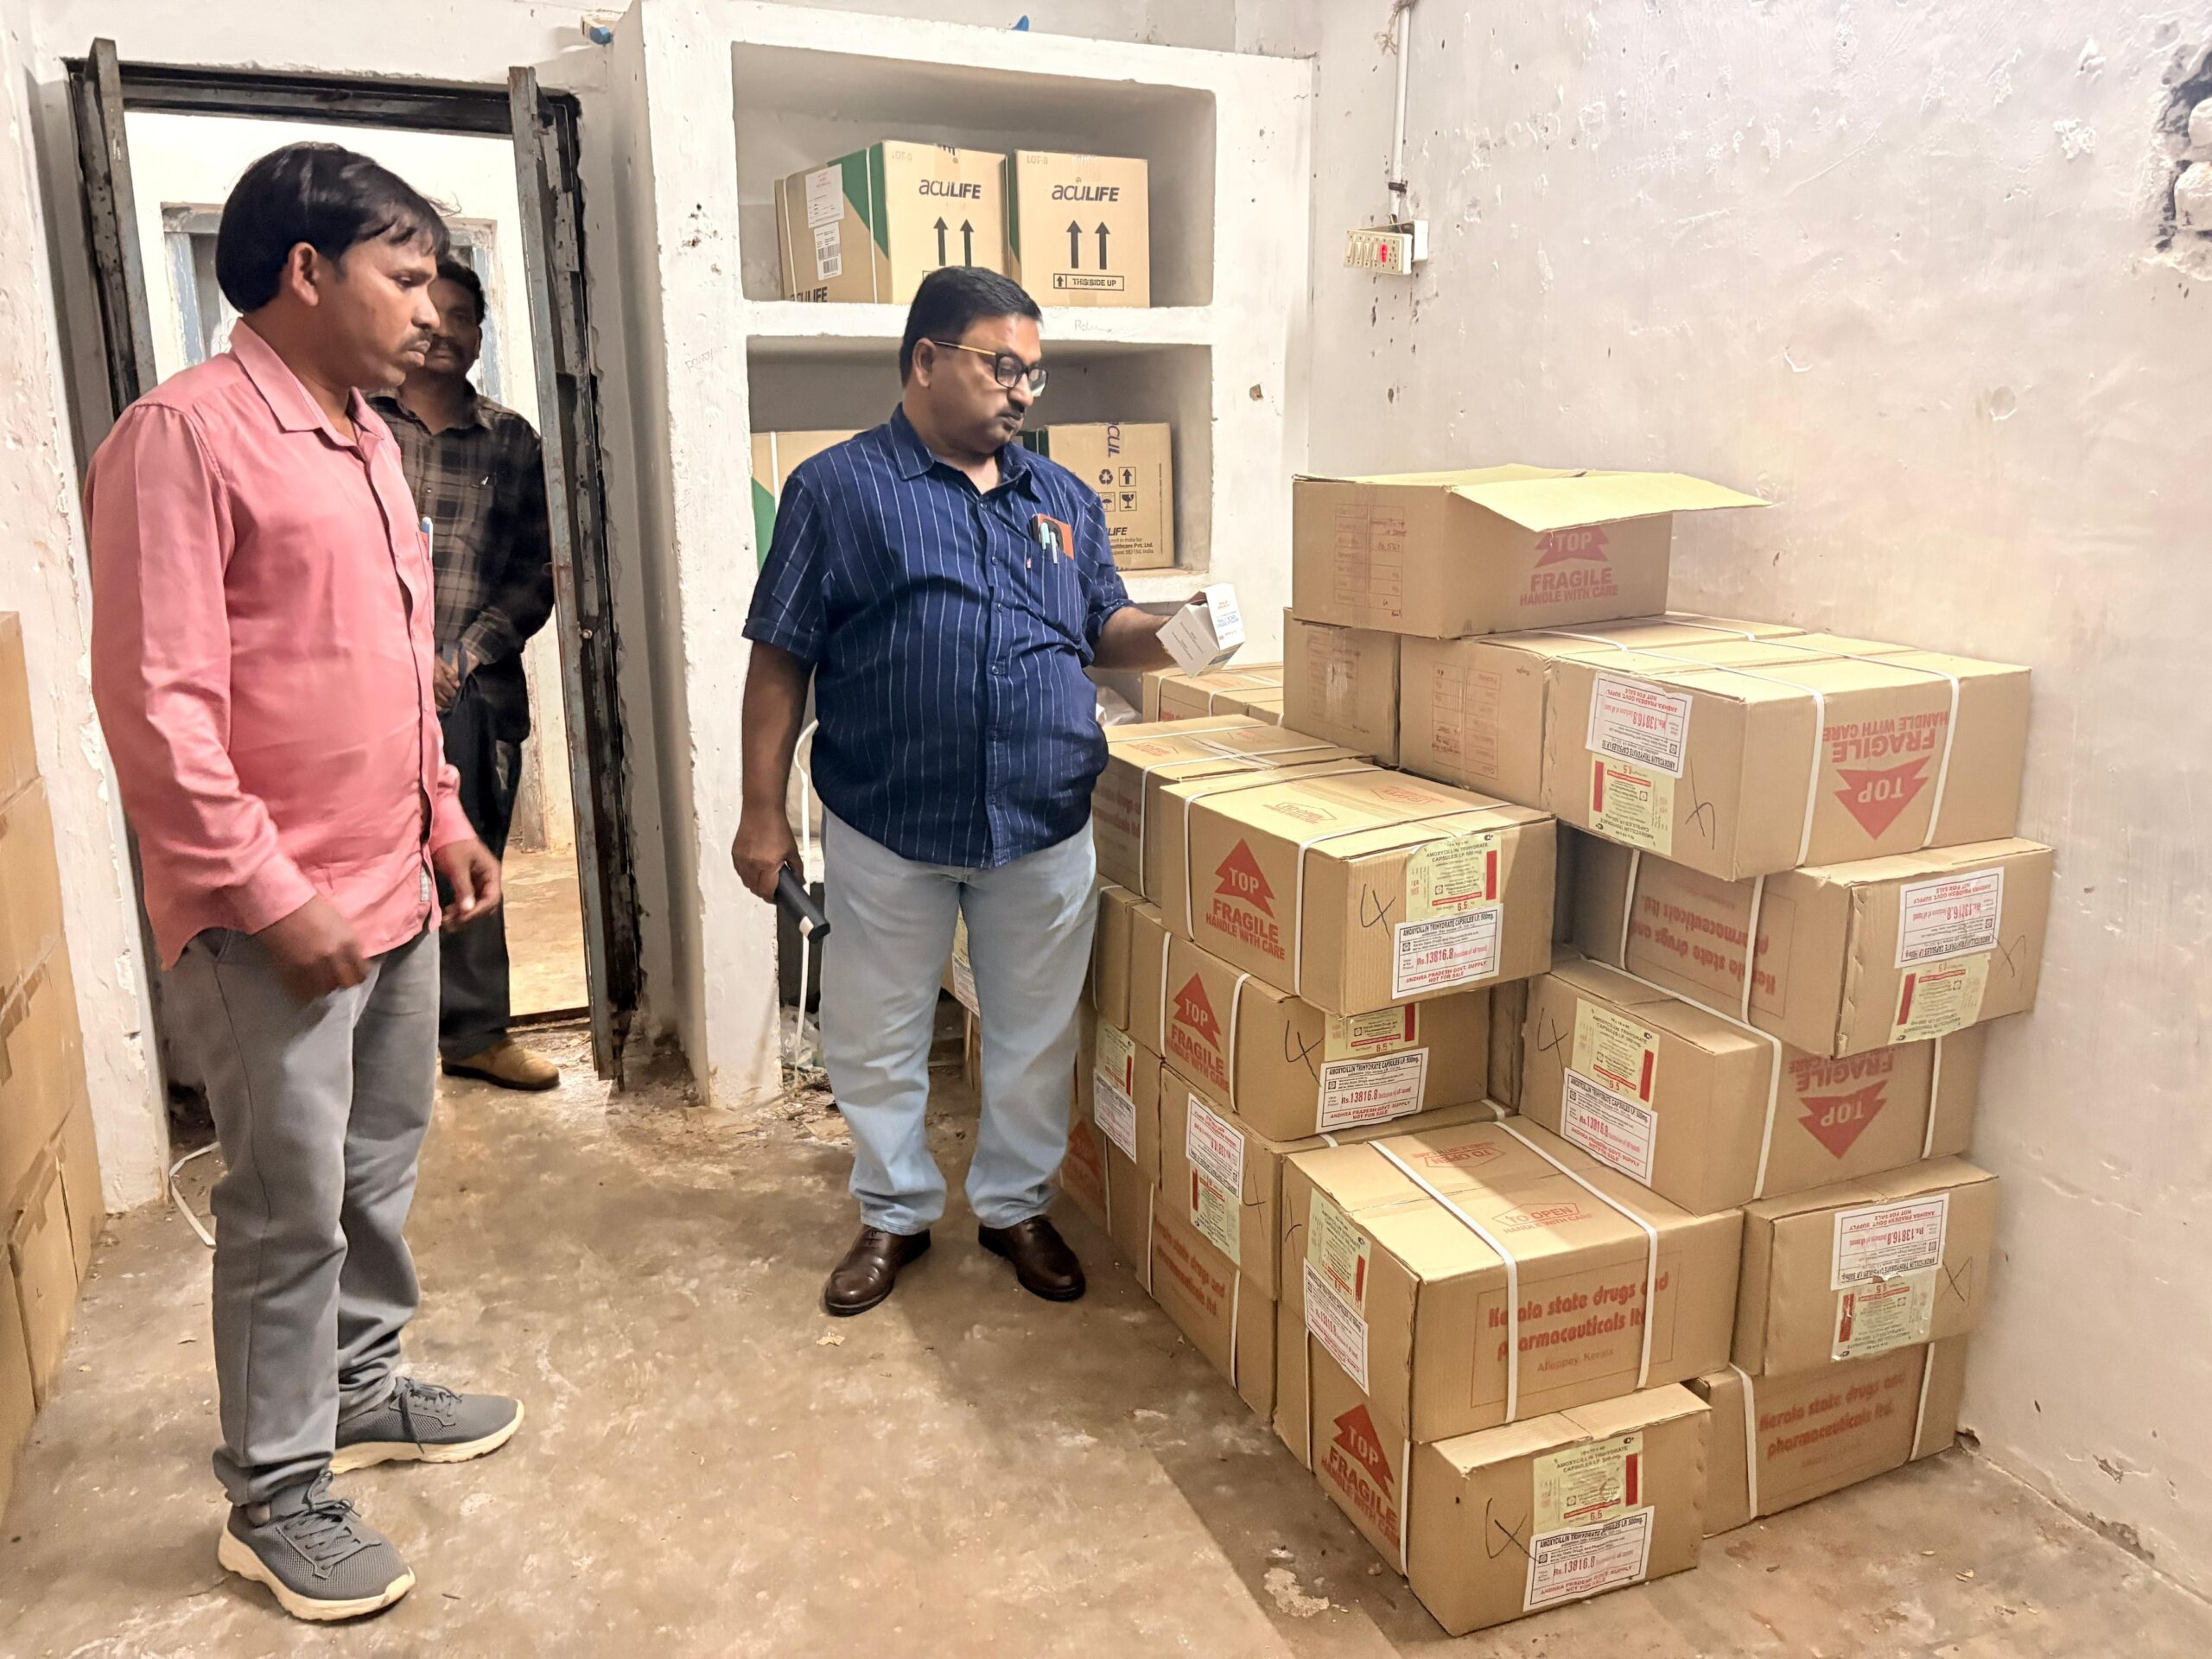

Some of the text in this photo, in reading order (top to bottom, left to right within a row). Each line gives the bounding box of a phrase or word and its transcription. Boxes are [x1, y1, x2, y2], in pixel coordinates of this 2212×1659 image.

[1072, 277, 1089, 286] THIS
[1090, 278, 1106, 287] SIDE
[1108, 527, 1128, 536] LIFE
[1555, 532, 1592, 552] TOP
[1531, 567, 1612, 592] FRAGILE
[1520, 585, 1618, 607] HANDLE WITH CARE
[1822, 711, 1948, 742] HANDLE WITH CARE
[1832, 729, 1936, 763] FRAGILE
[1858, 778, 1904, 803] TOP
[1229, 867, 1260, 893] TOP
[1457, 901, 1468, 912] 6.5
[1213, 898, 1279, 944] FRAGILE
[1403, 924, 1429, 937] AMOXYCILLIN
[1455, 916, 1474, 927] CAPSULES
[1663, 904, 1769, 955] parmaceuticals
[1206, 912, 1286, 961] HANDLE WITH CARE
[1656, 927, 1725, 972] state drugs
[1406, 975, 1427, 983] ANDHRA
[1428, 969, 1452, 978] PRADESH
[1468, 961, 1487, 969] SUPPLY
[1185, 998, 1209, 1027] TOP
[1171, 1022, 1224, 1076] FRAGILE
[1376, 1043, 1388, 1052] 6.5
[1329, 1065, 1355, 1075] AMOXYCILLIN
[1382, 1059, 1400, 1069] CAPSULES
[1796, 1053, 1893, 1092] FRAGILE
[1210, 1070, 1230, 1094] CARE
[1352, 1107, 1376, 1116] PRADESH
[1820, 1100, 1864, 1127] TOP
[1431, 1149, 1493, 1164] TO OPEN
[1506, 1206, 1573, 1224] TO OPEN
[1541, 1217, 1567, 1226] WITH
[1888, 1214, 1912, 1224] PRADESH
[1913, 1211, 1935, 1219] ANDHRA
[1488, 1300, 1542, 1328] Keala
[1547, 1293, 1587, 1316] state
[1593, 1281, 1636, 1306] drugs
[1497, 1311, 1625, 1362] parmaceuticals
[1584, 1347, 1614, 1362] Kerala
[1758, 1382, 1879, 1432] Kerala state drugs
[1767, 1406, 1872, 1460] pharmaceuticals
[1349, 1425, 1380, 1466] TOP
[1556, 1456, 1593, 1469] AMOXYCILLIN
[1563, 1462, 1592, 1472] CAPSULES
[1329, 1445, 1398, 1530] FRAGILE
[1590, 1510, 1603, 1521] 6.5
[1540, 1535, 1570, 1548] AMOXYCILLIN
[1610, 1566, 1632, 1575] SUPPLY
